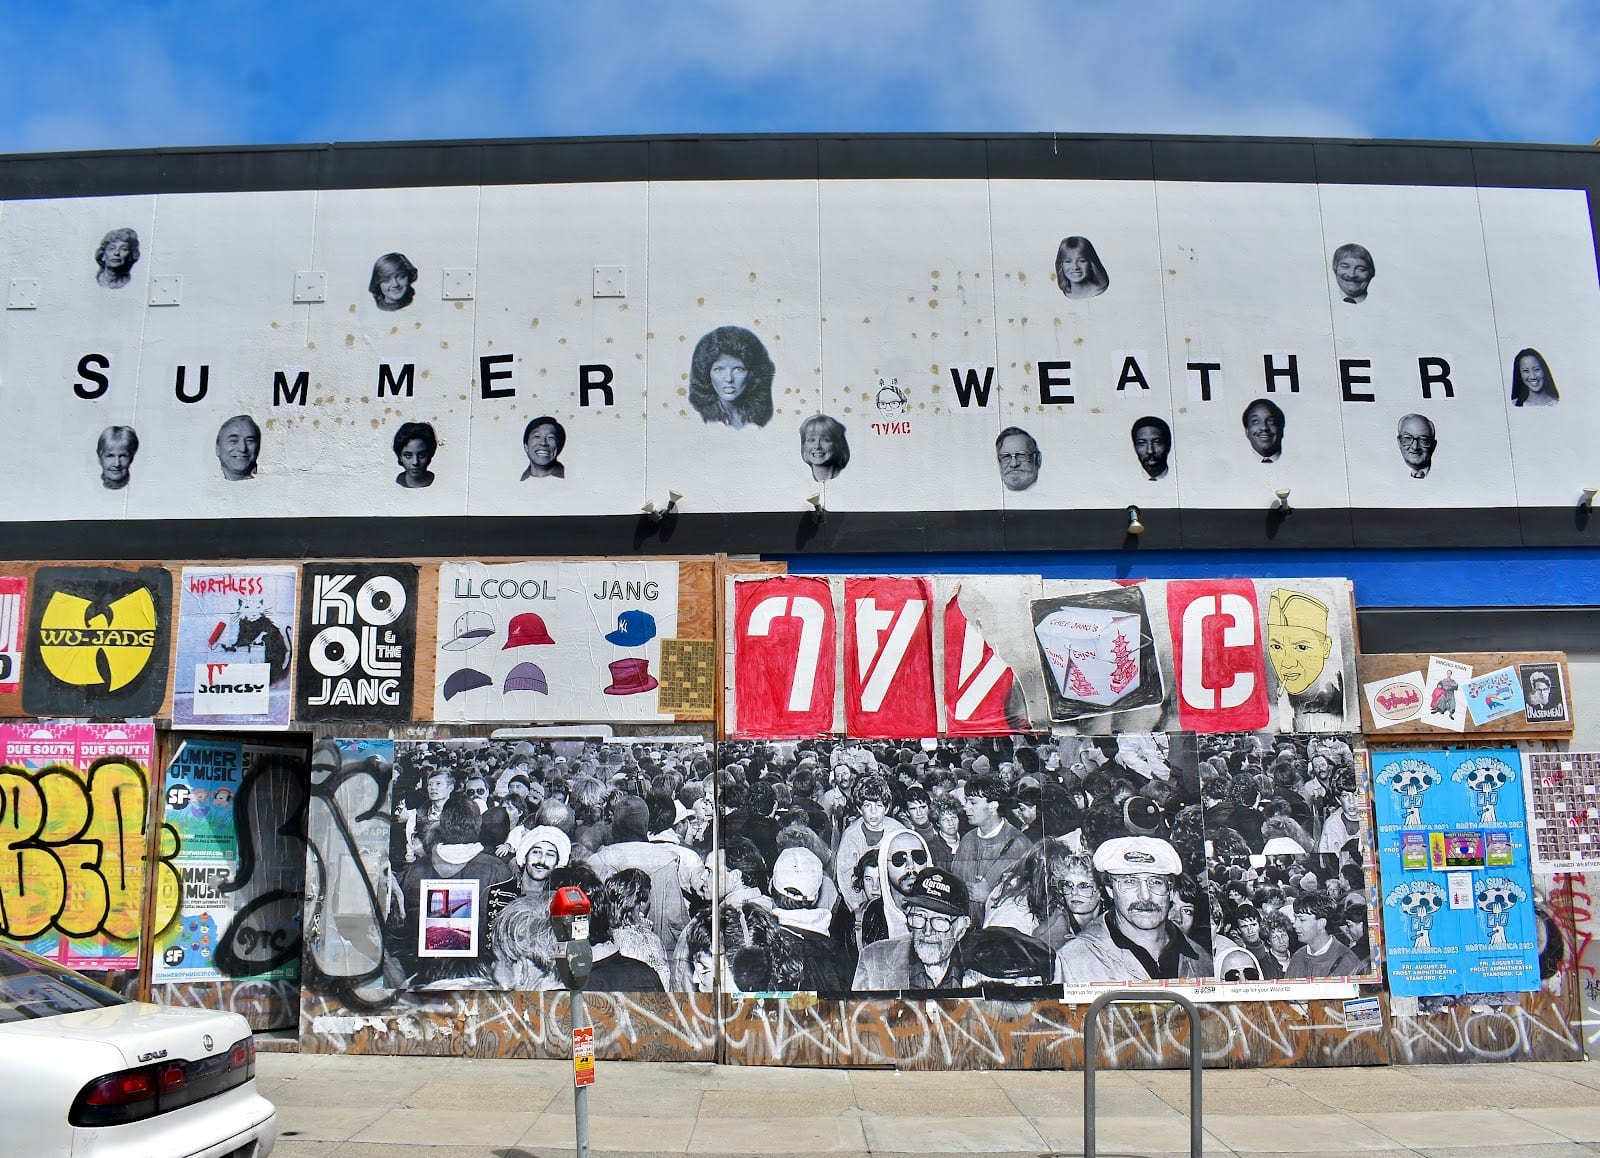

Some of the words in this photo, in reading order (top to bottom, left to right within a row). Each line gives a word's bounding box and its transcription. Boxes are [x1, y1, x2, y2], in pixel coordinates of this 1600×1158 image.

[74, 353, 614, 407] SUMMER
[951, 354, 1454, 407] WEATHER
[190, 576, 264, 595] WORTHLESS
[594, 580, 659, 601] JANG
[40, 630, 155, 647] WU-JANG
[377, 646, 402, 658] THE
[308, 679, 400, 706] JANG
[7, 744, 32, 755] DUE
[34, 744, 75, 755] SOUTH
[81, 745, 106, 755] DUE
[107, 745, 149, 755] SOUTH
[171, 765, 191, 780] OF
[193, 766, 237, 782] MUSIC
[169, 788, 188, 803] SF
[922, 878, 950, 893] Corona
[166, 949, 183, 963] SF
[137, 1049, 167, 1063] LEXUS
